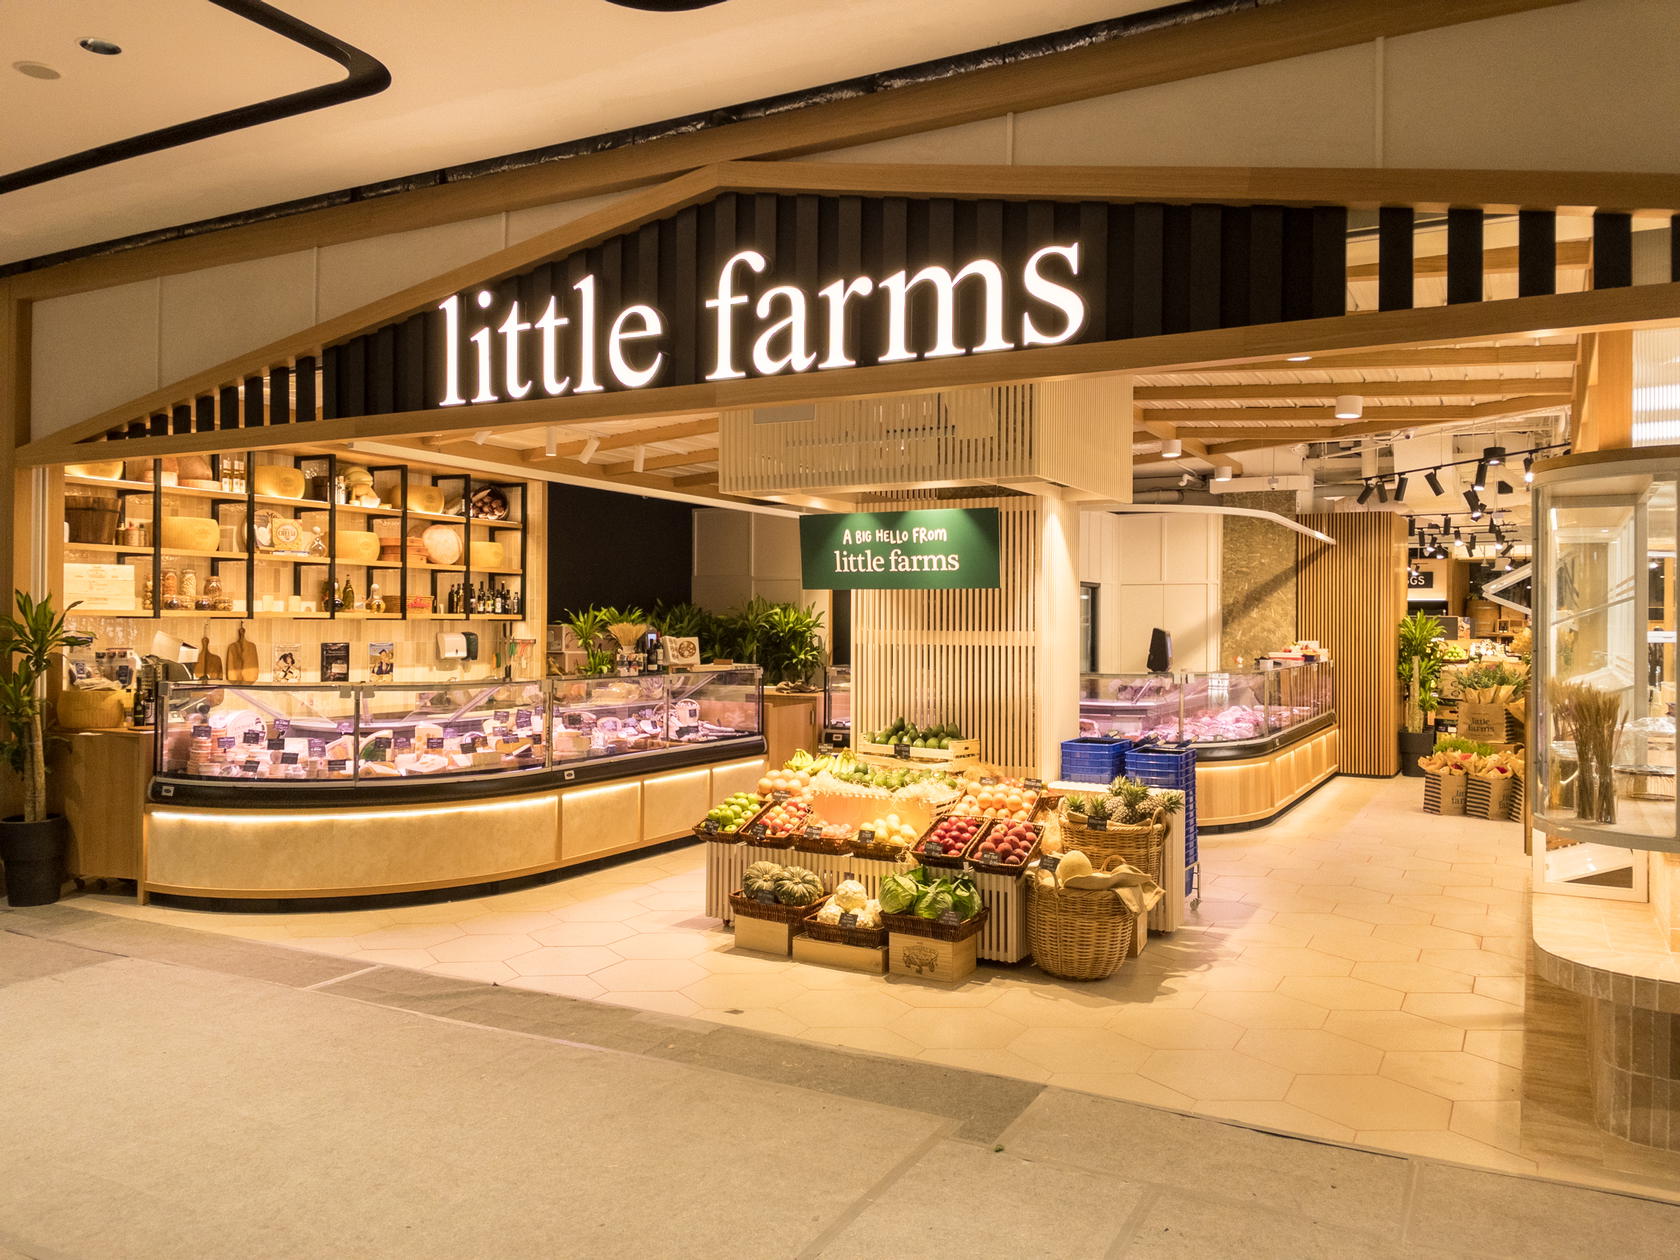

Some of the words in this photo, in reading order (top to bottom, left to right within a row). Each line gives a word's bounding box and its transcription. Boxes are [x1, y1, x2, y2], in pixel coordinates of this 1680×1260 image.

[439, 274, 664, 406] little
[705, 242, 1085, 381] farms
[843, 529, 852, 545] A
[855, 530, 872, 544] BIG
[875, 528, 909, 544] HELLO
[912, 527, 947, 544] FROM
[833, 549, 885, 573] little
[889, 549, 960, 572] farms
[1407, 575, 1425, 586] GS
[1471, 717, 1490, 725] little
[1467, 724, 1495, 733] farms
